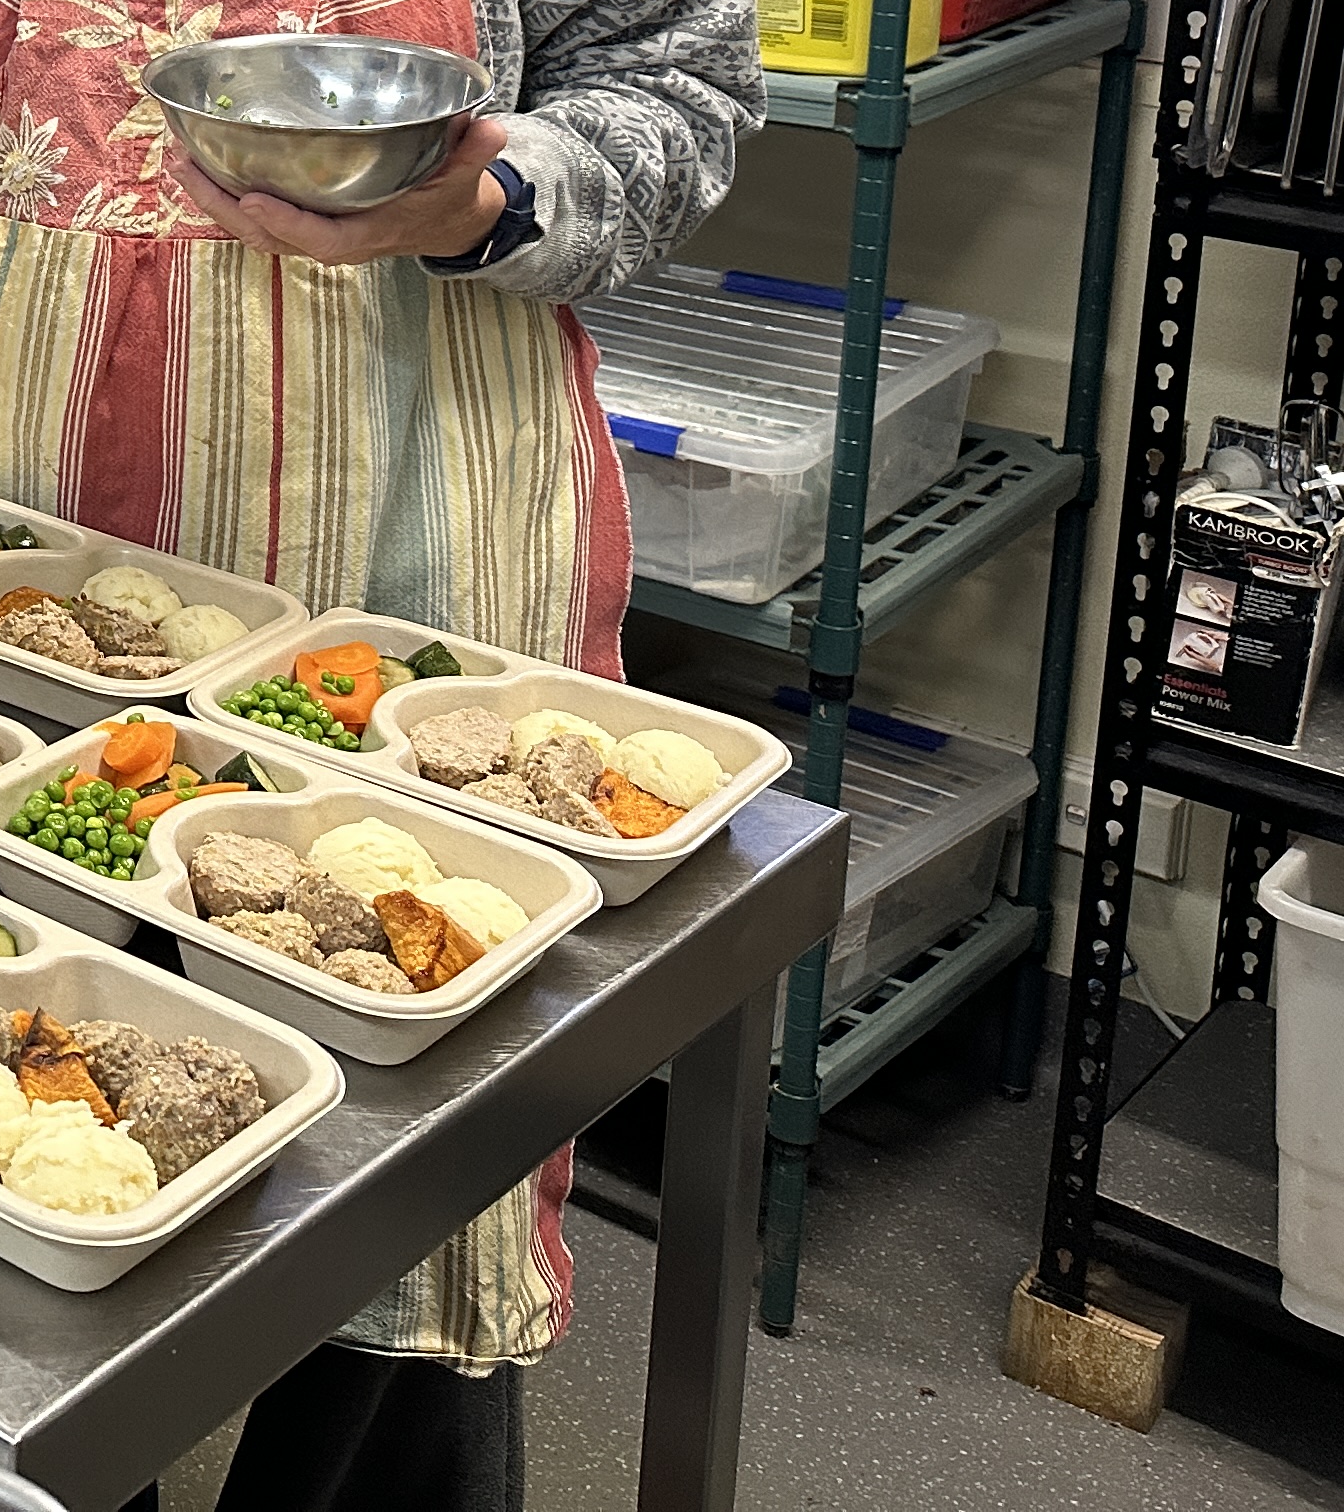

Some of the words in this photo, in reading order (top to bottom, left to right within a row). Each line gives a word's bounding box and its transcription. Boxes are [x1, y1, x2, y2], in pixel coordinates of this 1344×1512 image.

[1188, 511, 1310, 554] KAMBROOK
[1161, 684, 1205, 705] Power
[1206, 696, 1233, 713] Mix
[1163, 673, 1228, 699] Essentials
